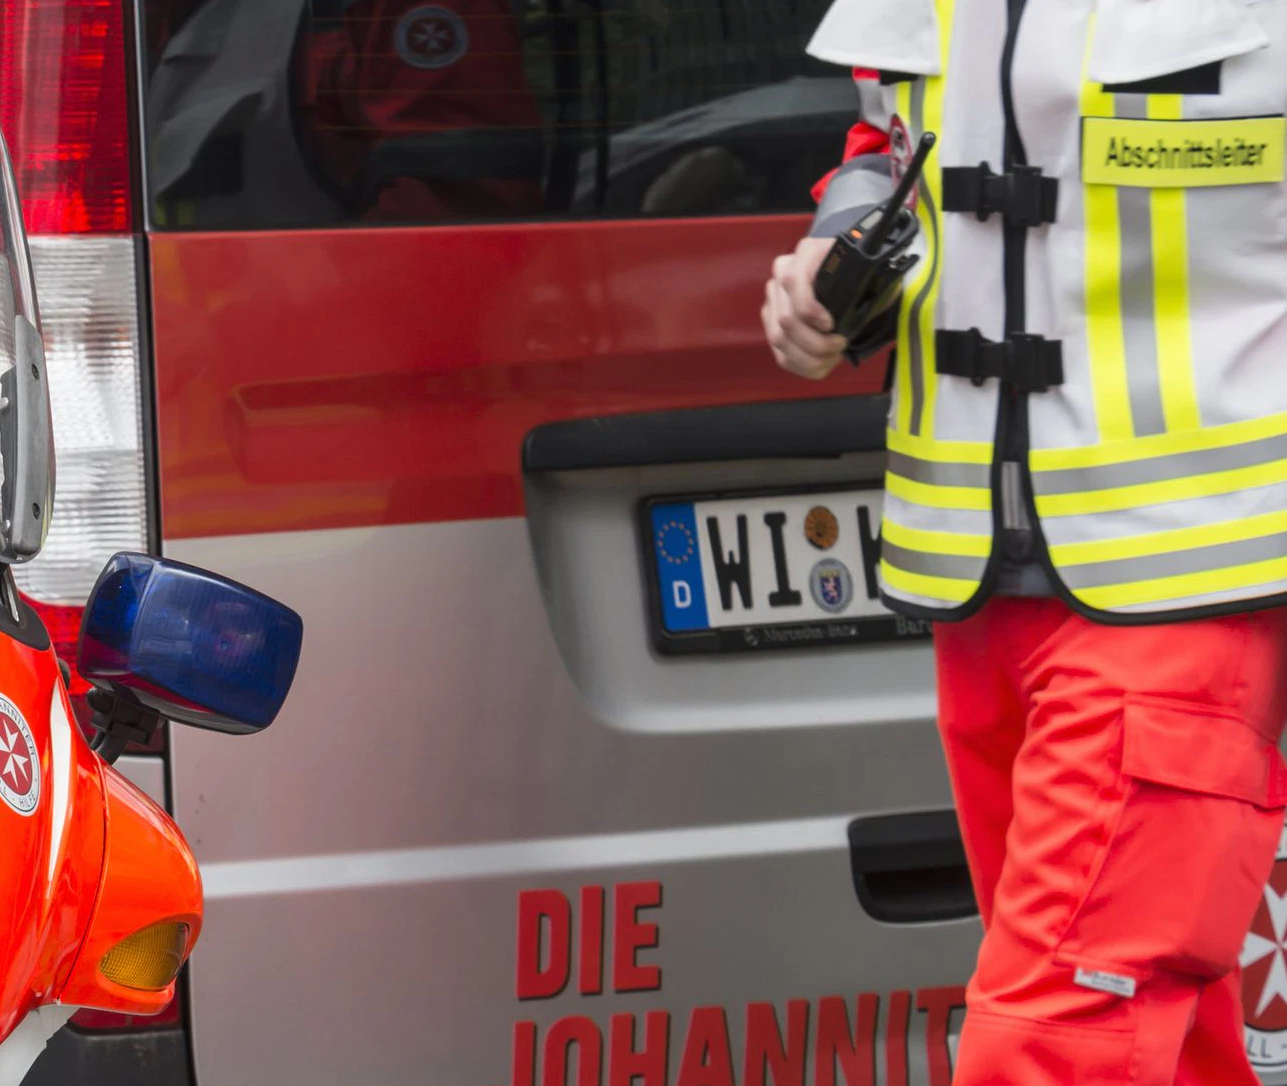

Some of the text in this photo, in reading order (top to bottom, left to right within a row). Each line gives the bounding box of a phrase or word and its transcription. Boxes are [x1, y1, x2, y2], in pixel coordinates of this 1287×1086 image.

[1106, 136, 1267, 169] Abschnittsleiter
[706, 511, 802, 611] WI
[673, 580, 692, 609] D
[516, 881, 663, 1001] DIE
